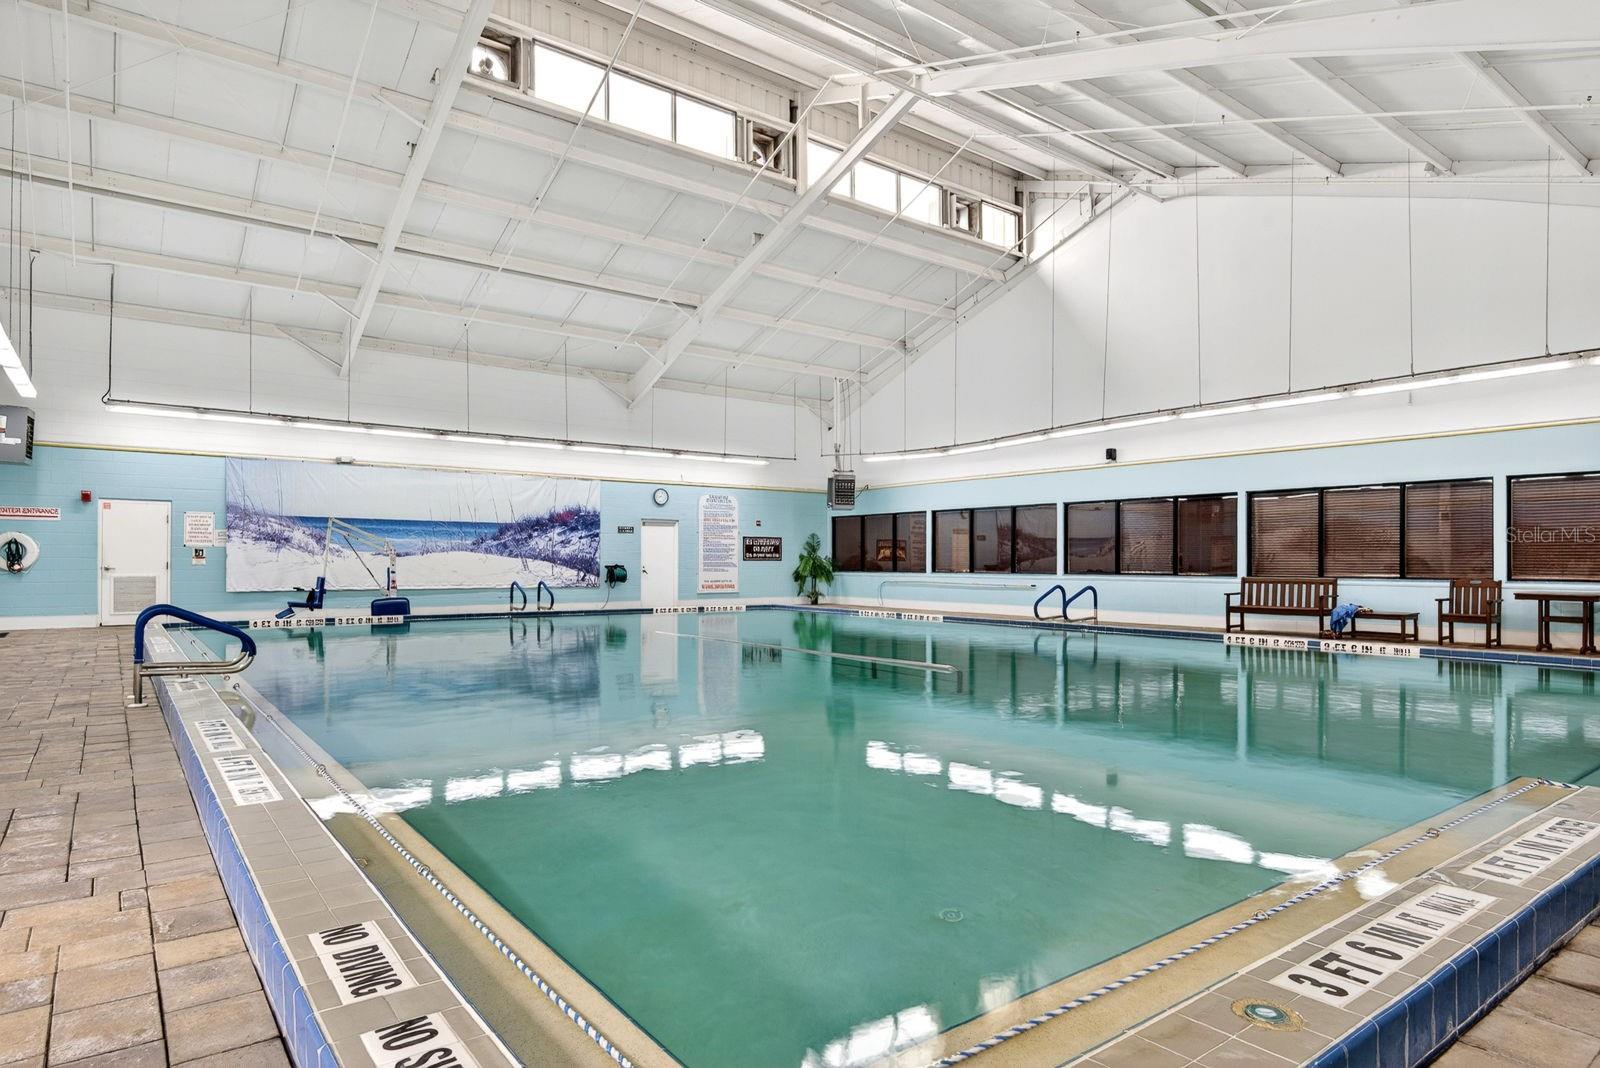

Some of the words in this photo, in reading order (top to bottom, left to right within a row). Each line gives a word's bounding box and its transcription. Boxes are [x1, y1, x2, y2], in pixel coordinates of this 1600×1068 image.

[1502, 848, 1551, 861] 6
[1513, 839, 1564, 855] IN
[1472, 866, 1521, 880] 4
[1484, 855, 1540, 874] FT
[1416, 892, 1480, 916] WALL
[1395, 912, 1445, 931] AT
[319, 923, 370, 946] NO
[1362, 922, 1433, 949] IN
[1345, 940, 1403, 961] 6
[332, 944, 403, 998] DIVING
[1309, 951, 1384, 985] FT
[1288, 973, 1349, 997] 3
[374, 1015, 439, 1051] NO
